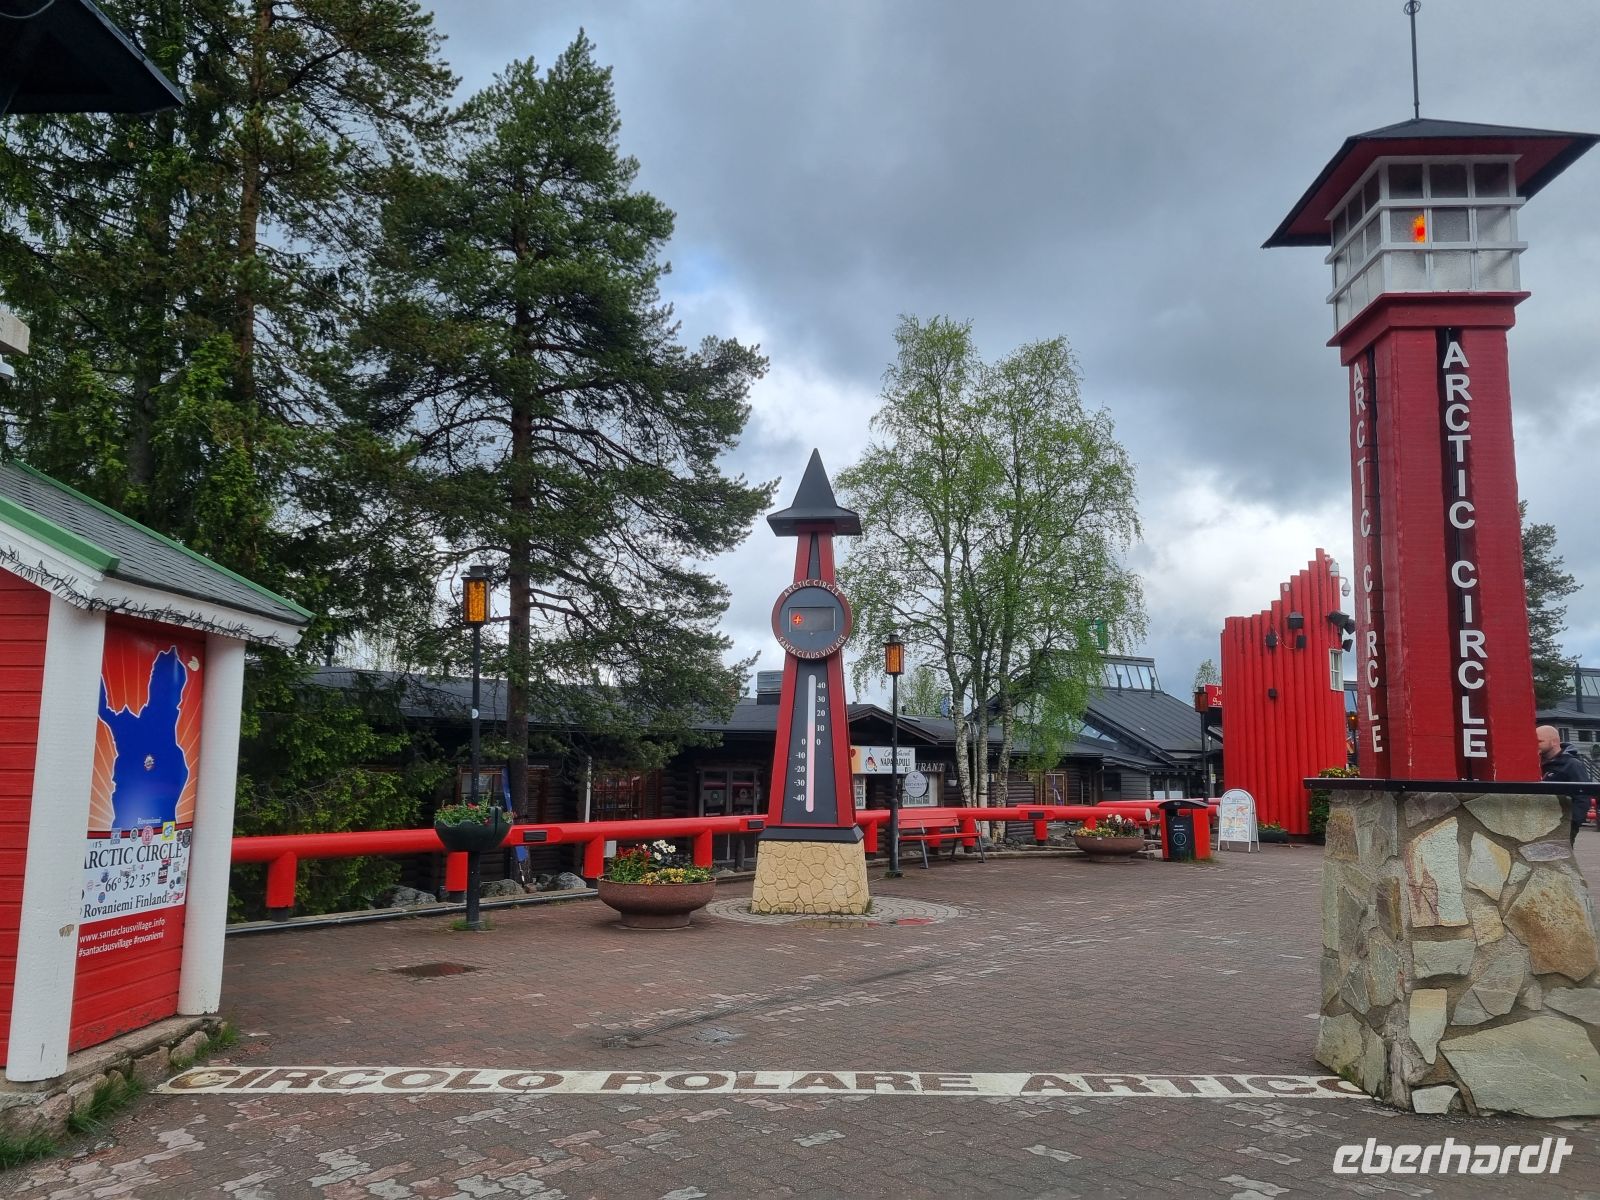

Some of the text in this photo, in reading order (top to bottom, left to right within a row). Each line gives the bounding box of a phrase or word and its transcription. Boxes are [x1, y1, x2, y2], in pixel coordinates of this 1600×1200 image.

[1353, 362, 1383, 753] ARCTIC CIRCLE
[1443, 341, 1488, 758] ARCTIC CIRCLE
[784, 580, 841, 597] ARCTIC CIRCLE
[777, 634, 847, 659] SANTA CLAUS VILLAGE
[136, 843, 183, 863] CIRCLE
[83, 897, 134, 918] Rovaniemi
[135, 890, 168, 908] Finland
[78, 929, 164, 957] #santaclausvillage #rovaniemi
[79, 917, 166, 943] www.santaclausvillage.info
[168, 1068, 564, 1090] CIRCOLO
[600, 1072, 979, 1092] POLARE
